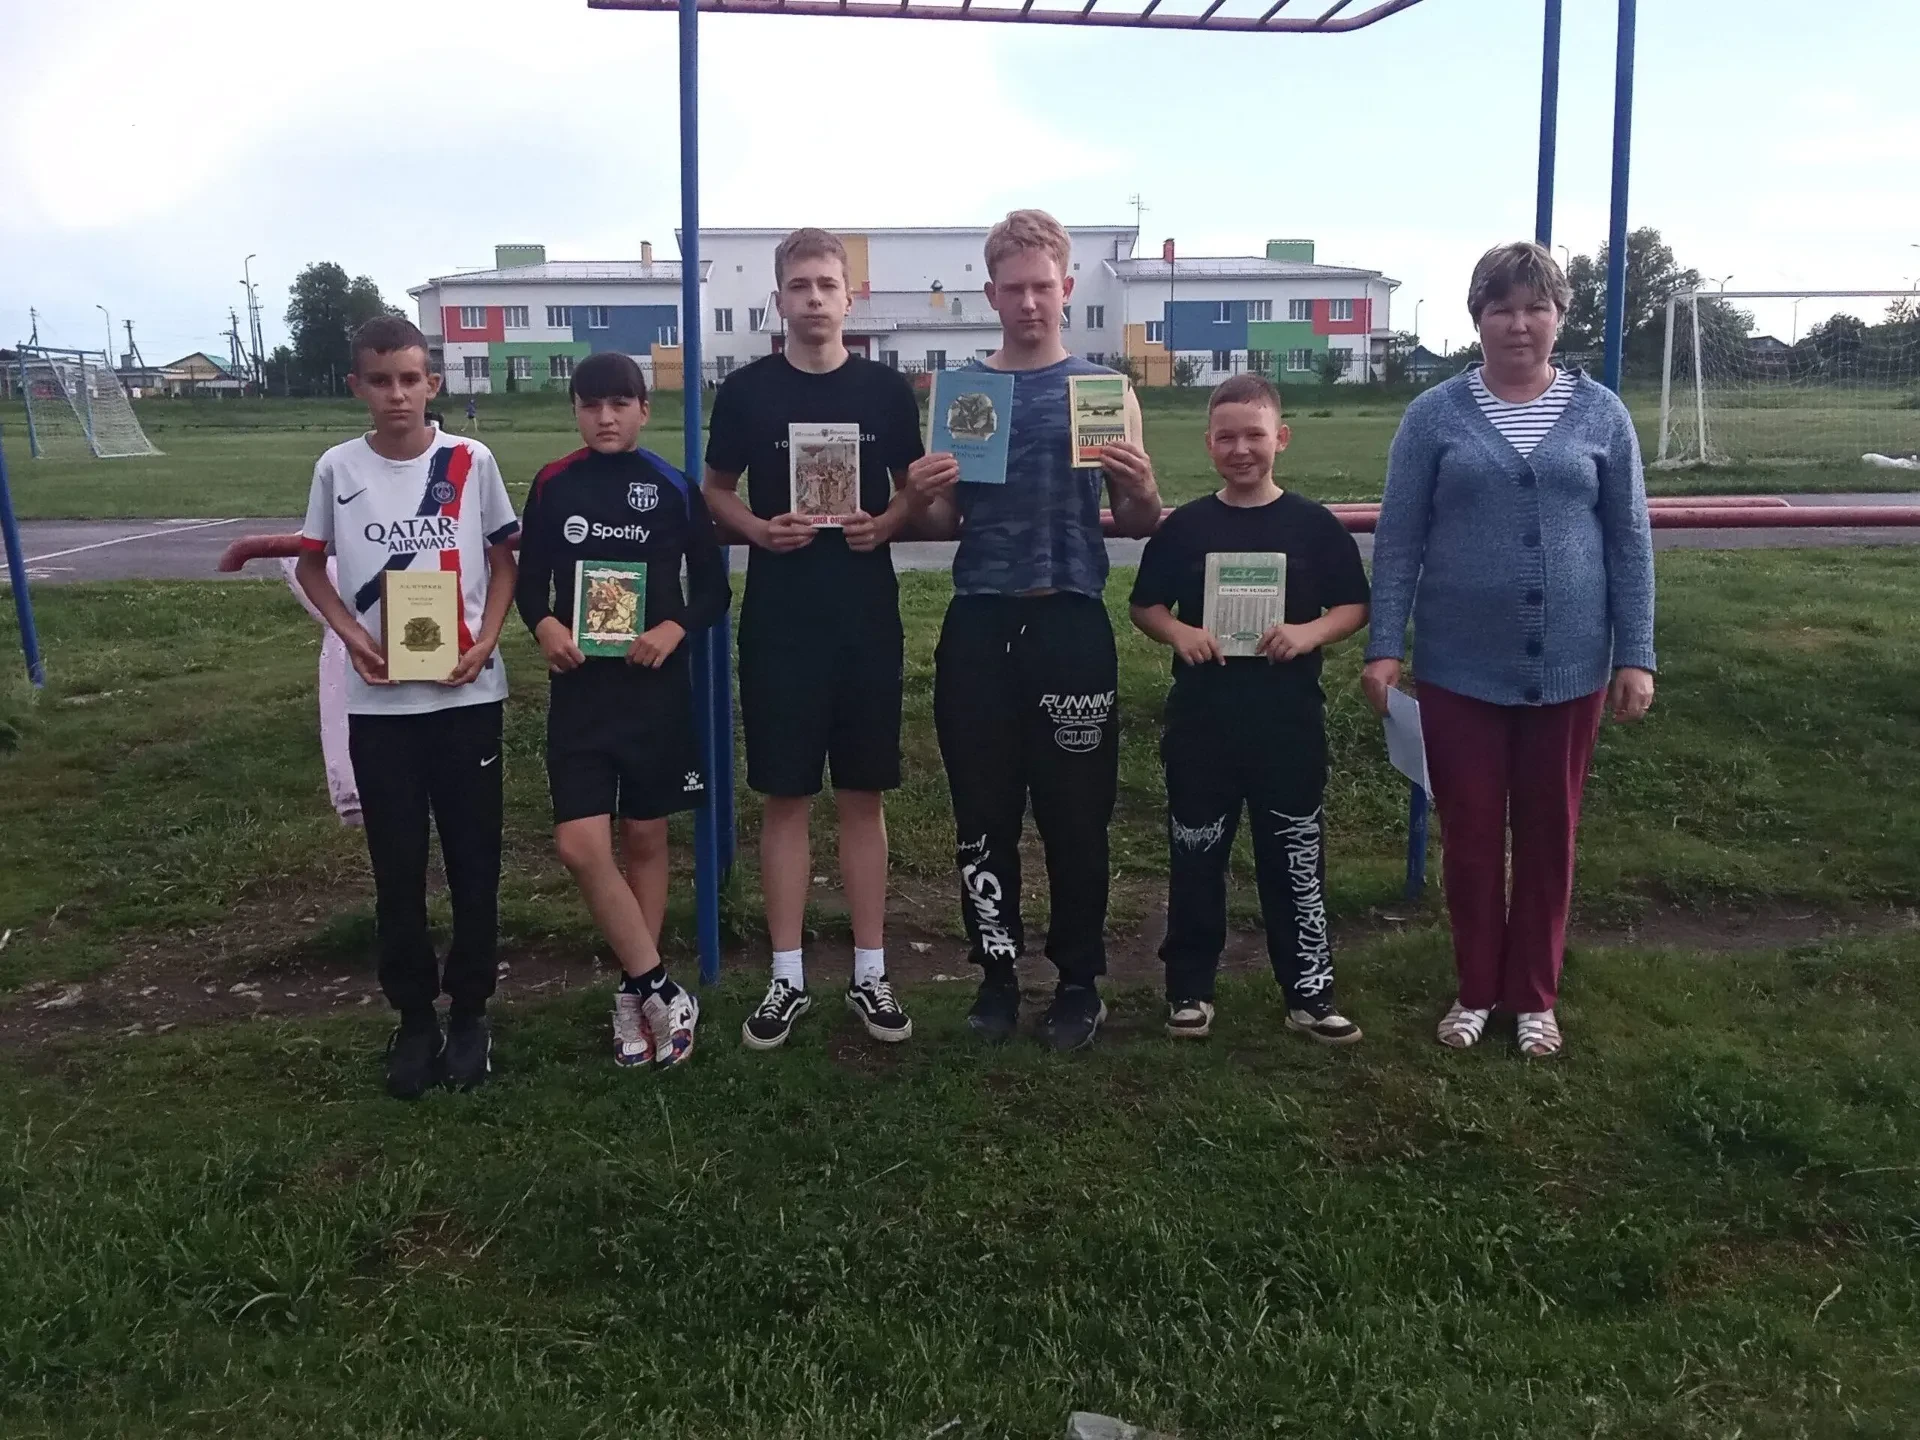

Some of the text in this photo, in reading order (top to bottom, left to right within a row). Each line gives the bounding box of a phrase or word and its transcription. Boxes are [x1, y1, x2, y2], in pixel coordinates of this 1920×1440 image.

[1079, 434, 1125, 446] ПУШКИН
[364, 517, 455, 545] QATAR
[591, 522, 650, 543] Spotify
[387, 536, 457, 553] AIRWAYS
